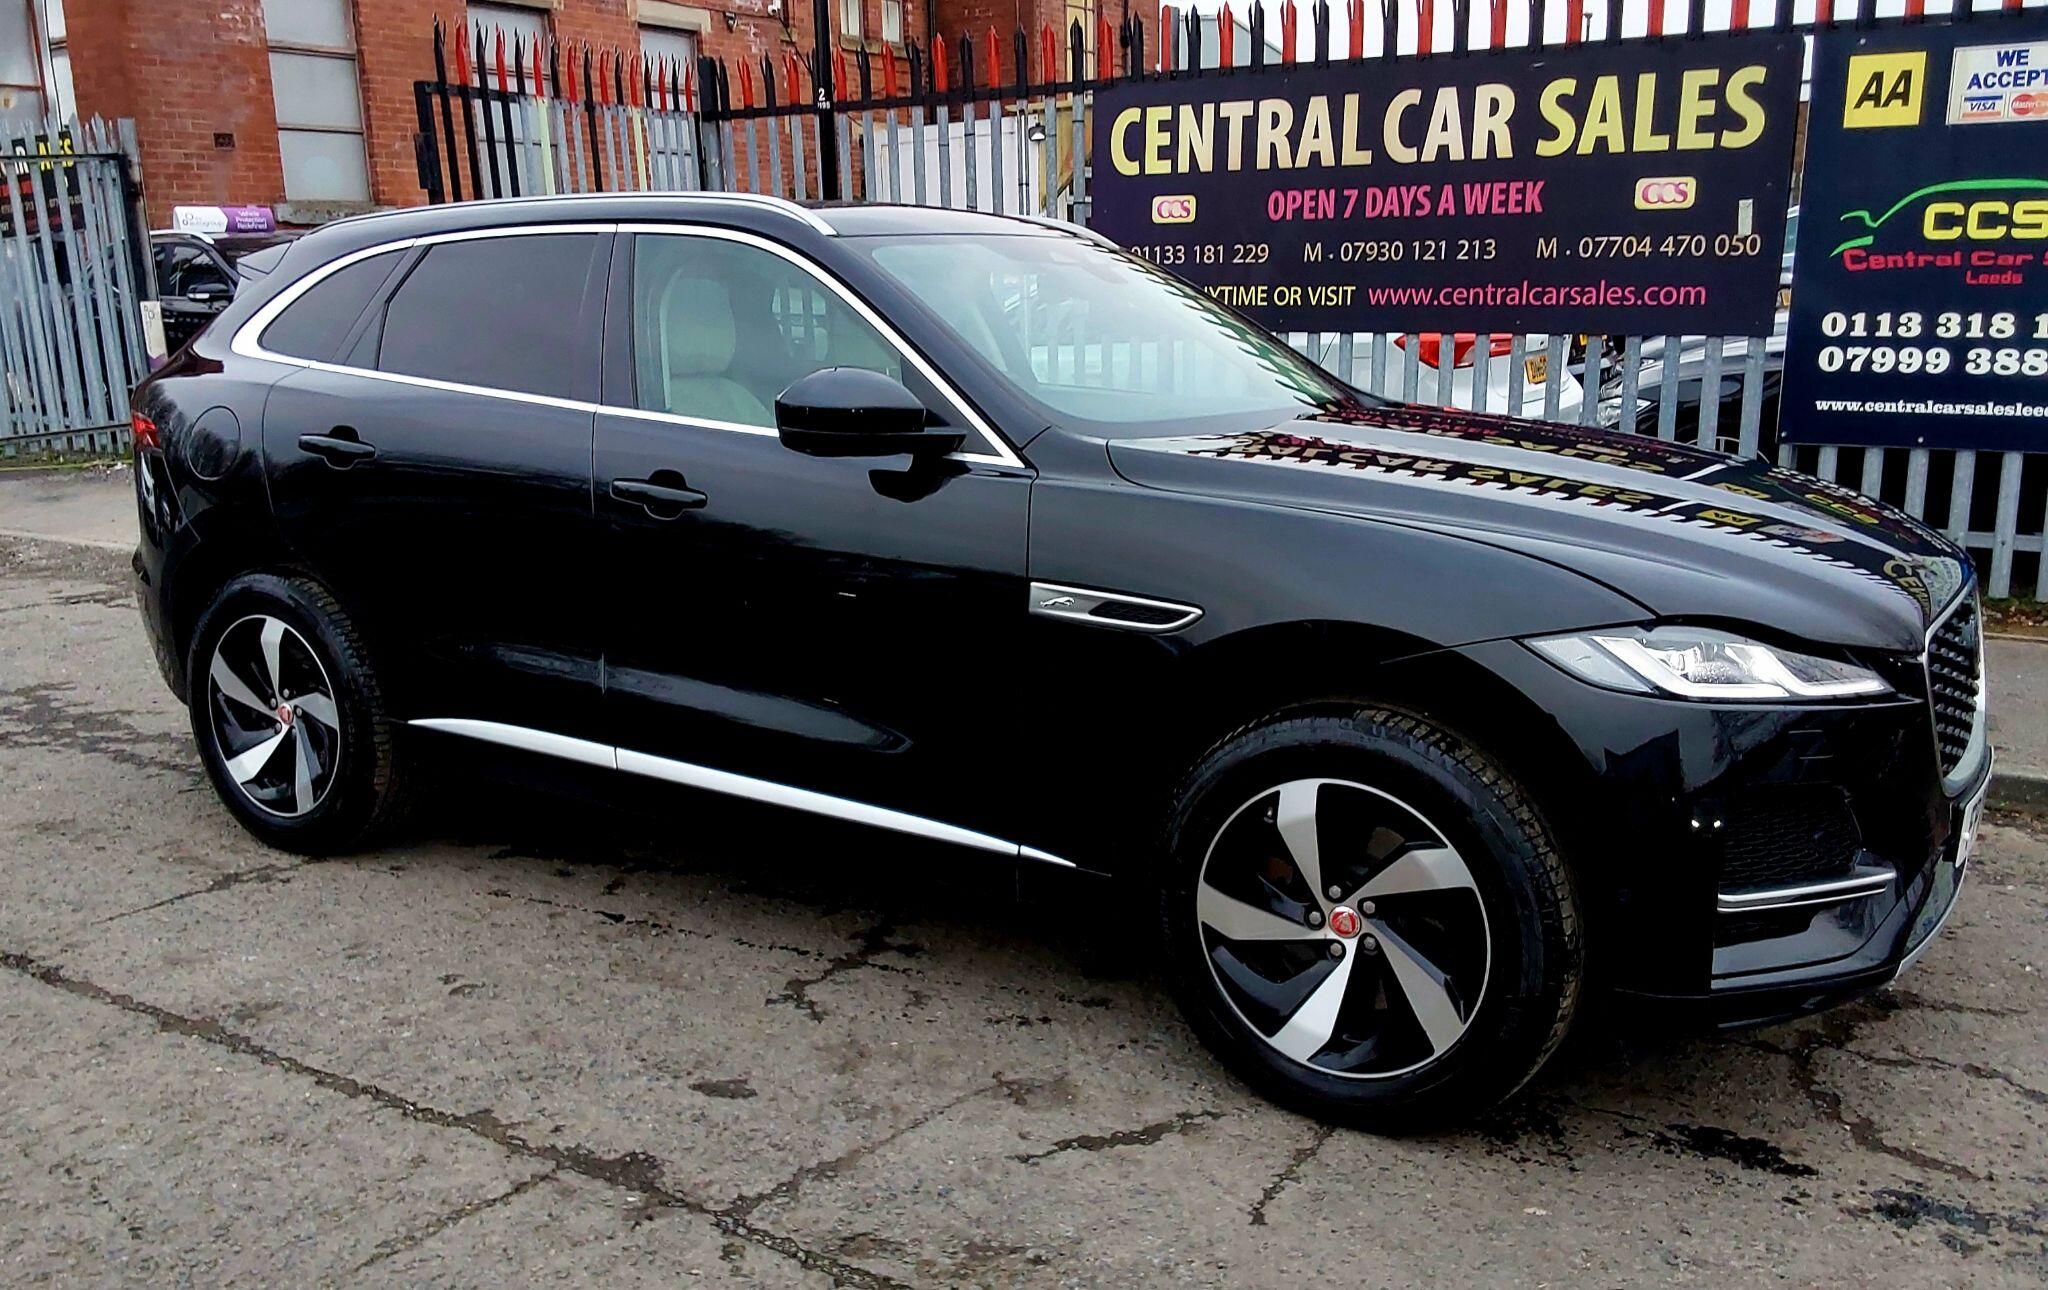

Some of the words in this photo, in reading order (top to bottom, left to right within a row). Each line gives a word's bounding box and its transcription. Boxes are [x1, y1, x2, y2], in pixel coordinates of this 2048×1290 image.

[1997, 49, 2030, 67] WE
[818, 87, 826, 101] 2
[1853, 69, 1912, 109] AA
[1970, 102, 1996, 111] VISA
[1110, 93, 1372, 176] CENTRAL
[1383, 83, 1515, 164] CAR
[1535, 65, 1767, 157] SALES
[1267, 189, 1335, 221] OPEN
[1343, 189, 1359, 218] 7
[1365, 185, 1431, 219] DAYS
[1437, 184, 1455, 216] A
[1463, 180, 1545, 216] WEEK
[1923, 201, 2048, 240] CCS
[1194, 244, 1224, 264] 181
[1233, 243, 1269, 263] 229
[1340, 241, 1403, 262] 07930
[1412, 240, 1446, 261] 121
[1456, 239, 1496, 260] 213
[1578, 236, 1651, 258] 07704
[1660, 235, 1706, 257] 470
[1714, 234, 1761, 257] 050
[1842, 248, 1962, 271] Central
[1971, 251, 2034, 266] Car
[1965, 270, 2023, 285] Leeds
[1204, 286, 1268, 306] YTIME
[1274, 286, 1302, 306] OR
[1308, 285, 1356, 306] VISIT
[1368, 279, 1706, 306] www.centralcarsales.com
[1821, 312, 1922, 338] 0113
[1936, 312, 2015, 338] 318
[1818, 346, 1950, 374] 07999
[1965, 348, 2048, 376] 388
[1815, 399, 2048, 417] www.centralcarsaleslee
